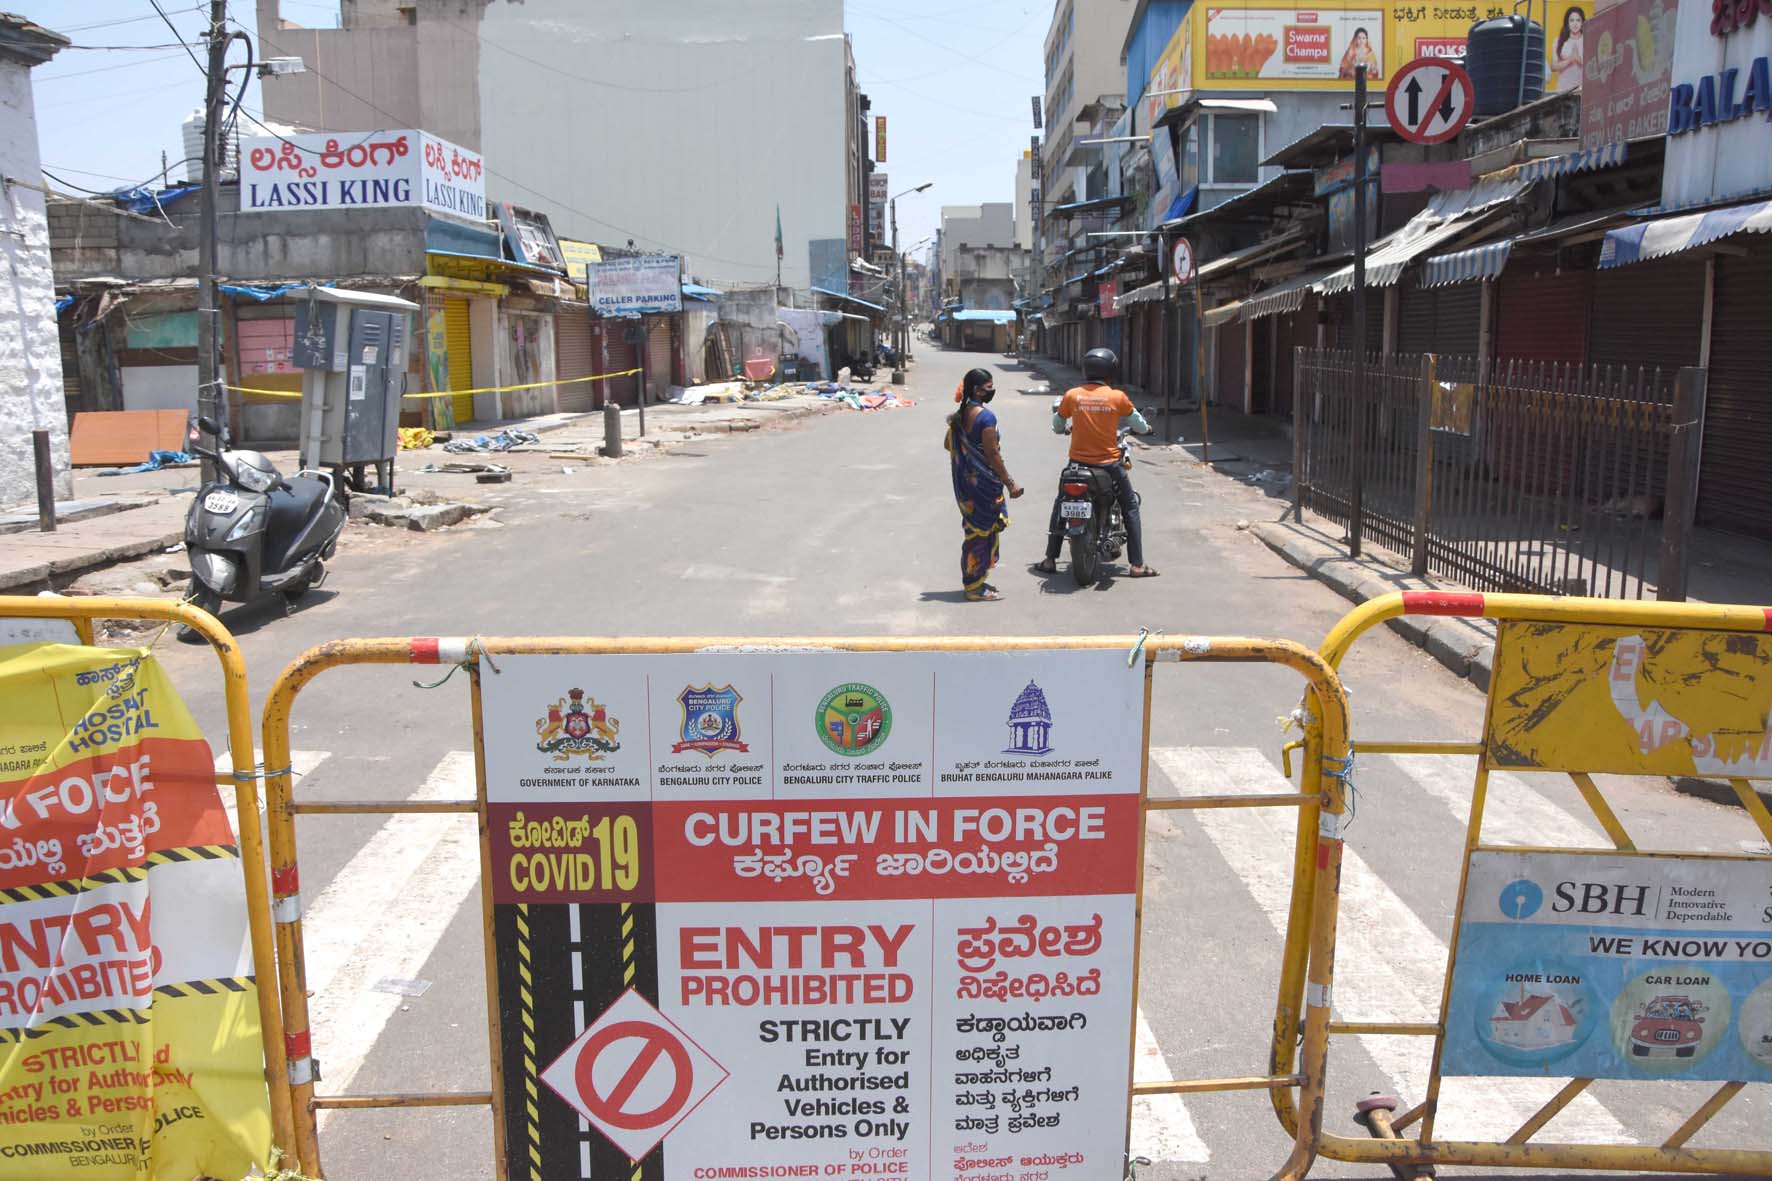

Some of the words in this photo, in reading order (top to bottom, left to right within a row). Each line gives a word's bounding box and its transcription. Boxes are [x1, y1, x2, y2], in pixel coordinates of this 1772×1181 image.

[1289, 30, 1326, 43] Swarna
[1286, 44, 1328, 58] Champa
[1421, 45, 1467, 58] MOKS
[1668, 57, 1772, 136] BALA
[1629, 110, 1668, 138] BAKER
[249, 181, 329, 208] LASSI
[340, 178, 410, 204] KING
[425, 178, 458, 210] LASSI
[459, 192, 483, 217] KING
[598, 295, 633, 305] CELLER
[635, 293, 677, 303] PARKING
[520, 778, 576, 787] GOVERNMENT
[578, 778, 590, 787] OF
[591, 778, 641, 787] KARNATAKA
[660, 776, 710, 786] BENGALURU
[712, 776, 730, 785] CITY
[733, 776, 762, 785] POLICE
[784, 776, 833, 784] BENGALURU
[835, 775, 854, 784] CITY
[856, 775, 890, 784] TRAFFIC
[892, 774, 921, 783] POLICE
[941, 773, 973, 783] BRUHAT
[975, 772, 1024, 782] BENGALURU
[1026, 771, 1082, 781] MAHANAGARA
[1085, 770, 1112, 780] PALIKE
[684, 810, 882, 846] CURFEW
[895, 808, 937, 844] IN
[953, 806, 1106, 843] FORCE
[510, 853, 595, 892] COVID
[593, 815, 639, 891] 19
[876, 843, 1059, 884] ಜಾರಿಯಲ್ಲಿದೆ
[1551, 881, 1650, 916] SBH
[1670, 887, 1715, 897] Modern
[1668, 898, 1726, 910] Innovative
[1666, 910, 1733, 922] Dependable
[0, 896, 151, 973] NTRY
[957, 913, 1103, 973] ಪ್ರವೇಶ
[679, 924, 916, 970] ENTRY
[1589, 936, 1633, 955] WE
[1641, 939, 1729, 957] KNOW
[1735, 941, 1772, 958] YO
[0, 944, 162, 1016] ROHIBITED
[681, 973, 914, 1006] PROHIBITED
[956, 968, 1101, 1003] ನಿಷೇಧಿಸಿದೆ
[1505, 973, 1542, 983] HOME
[1546, 974, 1580, 984] LOAN
[1645, 975, 1672, 985] CAR
[1676, 976, 1710, 985] LOAN
[759, 1018, 912, 1043] STRICTLY
[956, 1012, 1087, 1042] ಕಡ್ಡಾಯವಾಗಿ
[22, 1040, 140, 1073] STRICTLY
[805, 1048, 869, 1070] Entry
[876, 1047, 910, 1065] for
[955, 1044, 1020, 1068] ಅಧಿಕೃತ
[48, 1075, 80, 1095] for
[777, 1071, 910, 1092] Authorised
[67, 1098, 82, 1117] &
[784, 1097, 886, 1117] Vehicles
[892, 1096, 910, 1114] &
[955, 1090, 996, 1110] ಮತ್ತು
[750, 1121, 848, 1140] Persons
[854, 1119, 910, 1141] Only
[955, 1115, 1000, 1134] ಮಾತ್ರ
[1008, 1112, 1061, 1134] ಪ್ರವೇಶ
[1, 1137, 136, 1158] COMMISSIONER
[849, 1148, 865, 1161] by
[868, 1147, 908, 1159] Order
[694, 1165, 819, 1180] COMMISSIONER
[824, 1163, 847, 1176] OF
[851, 1161, 908, 1175] POLICE
